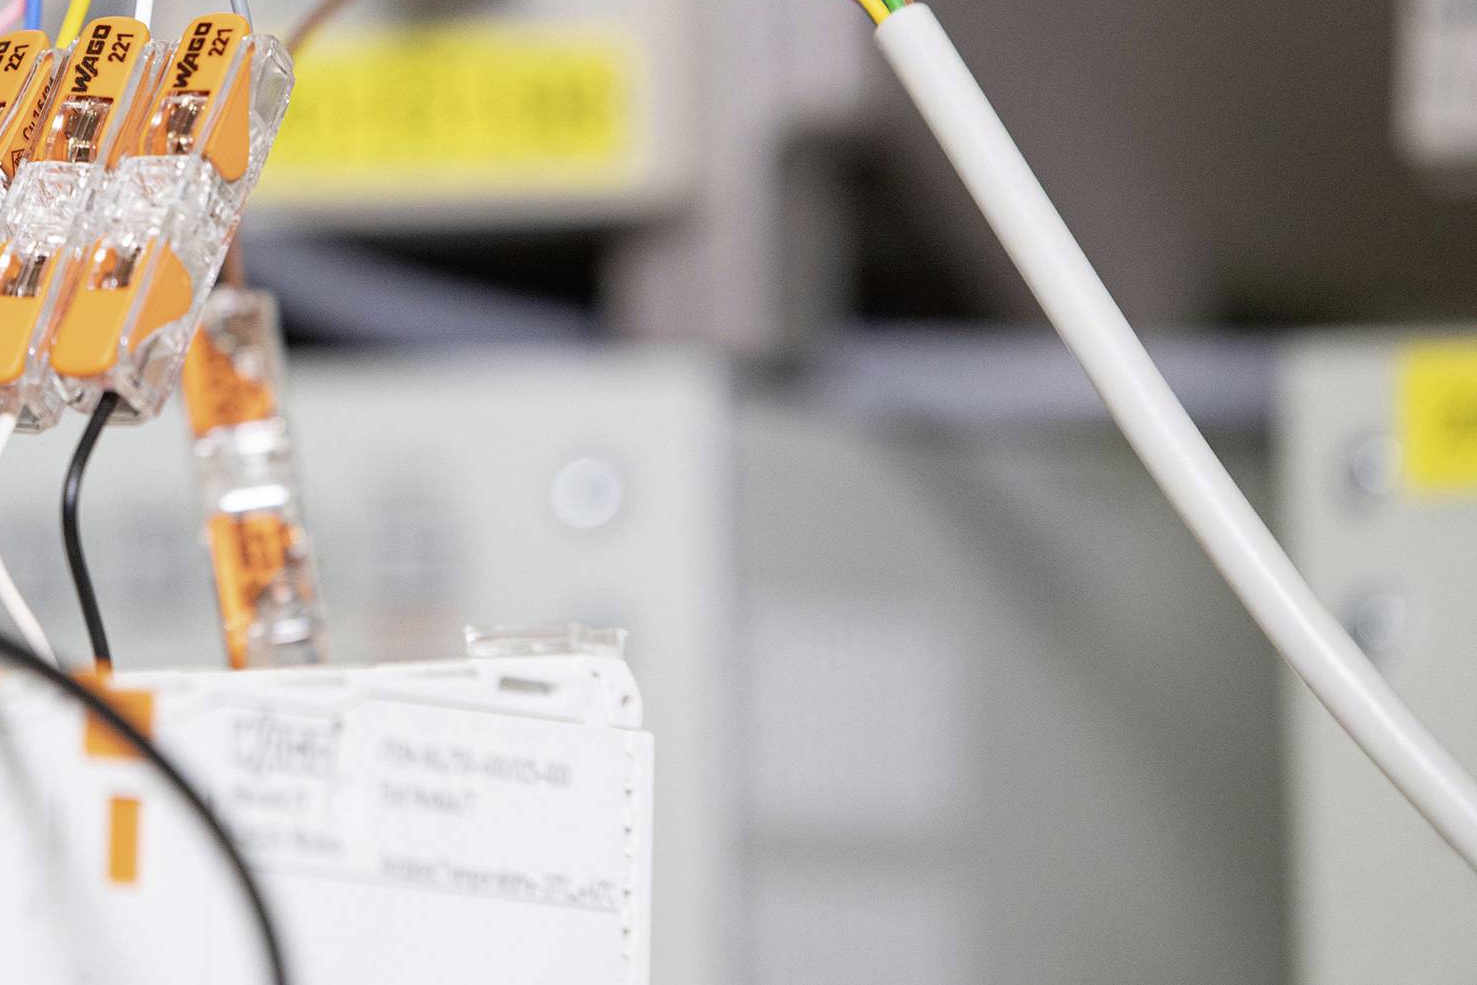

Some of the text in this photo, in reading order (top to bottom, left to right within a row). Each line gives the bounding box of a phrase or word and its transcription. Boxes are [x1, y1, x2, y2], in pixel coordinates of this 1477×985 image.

[4, 43, 29, 72] 221
[108, 33, 134, 63] 221
[173, 22, 212, 89] WAGO
[208, 28, 233, 57] 221
[71, 24, 111, 93] WAGO
